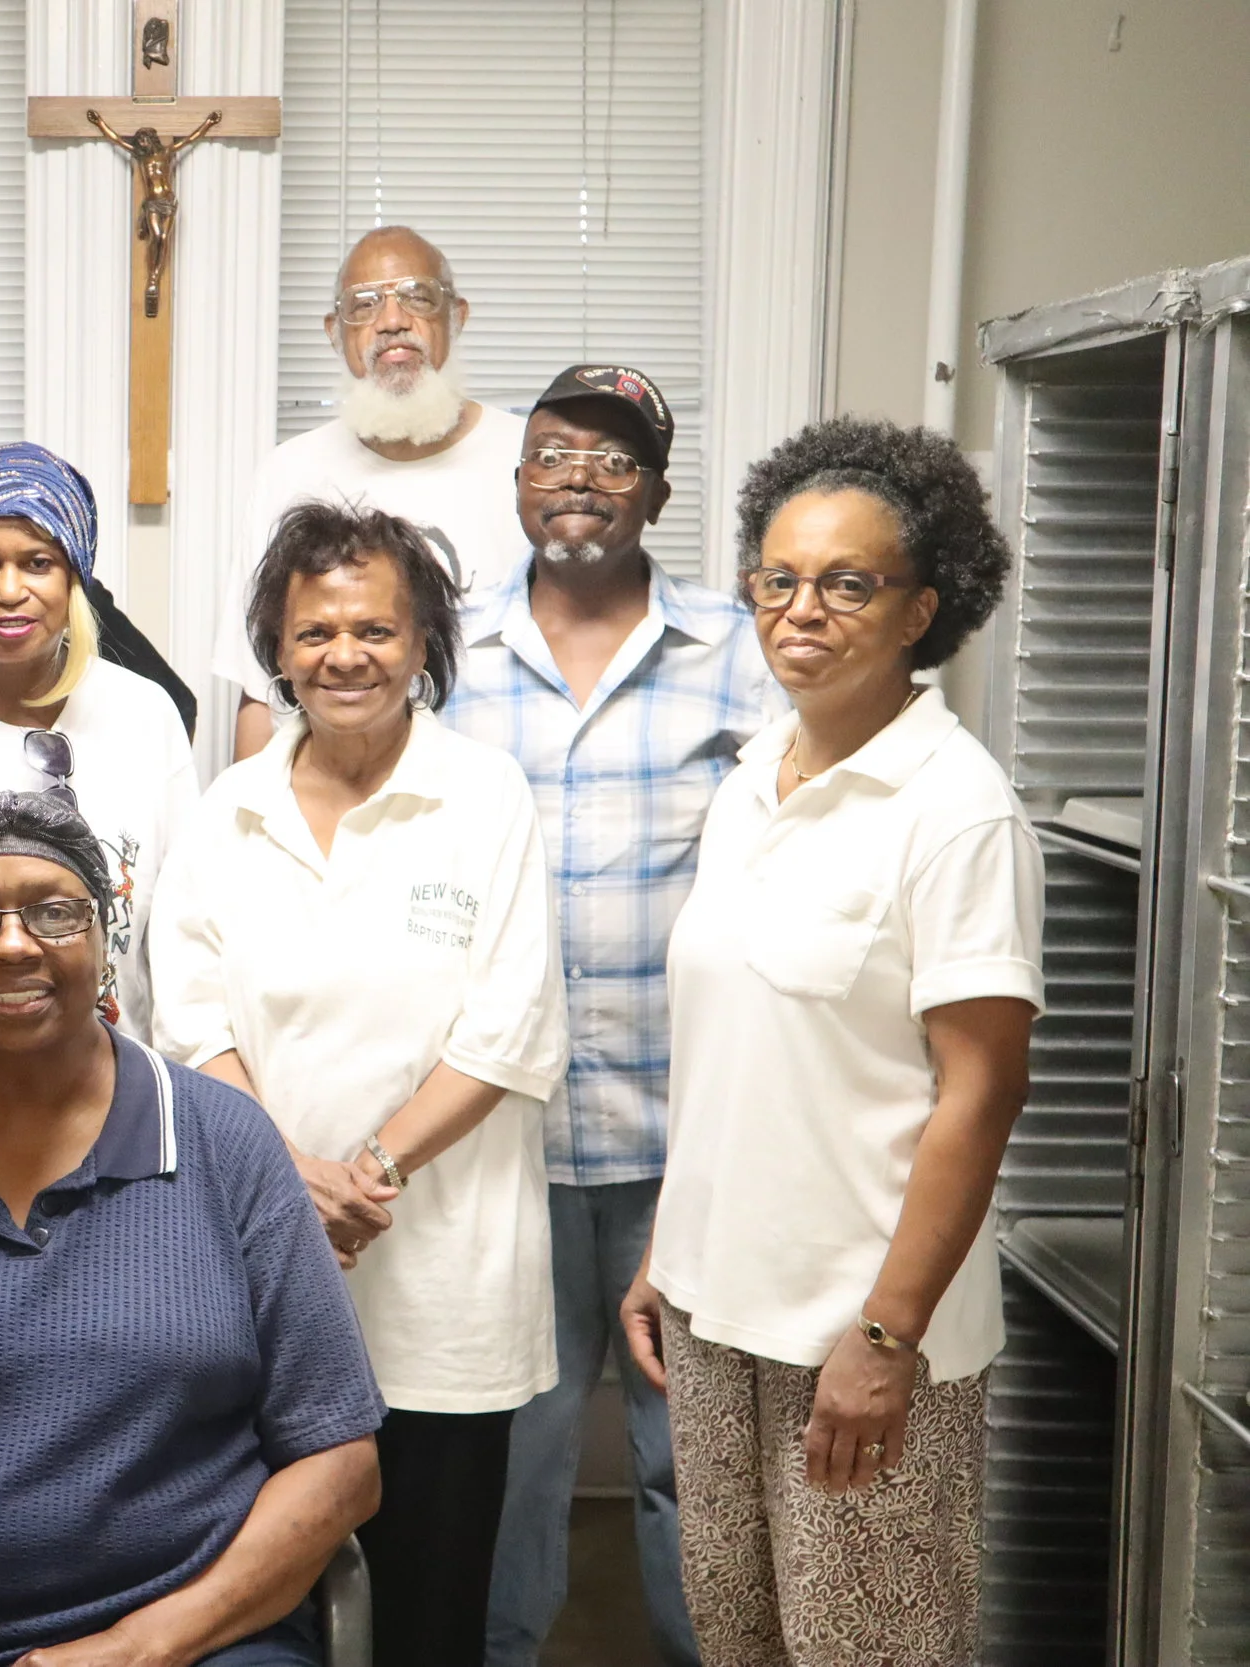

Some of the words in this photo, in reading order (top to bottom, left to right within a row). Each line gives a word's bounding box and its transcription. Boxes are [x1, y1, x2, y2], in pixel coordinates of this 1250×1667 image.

[617, 368, 665, 420] AIRBORNE
[410, 882, 447, 902] NEW
[407, 918, 448, 946] BAPTIST
